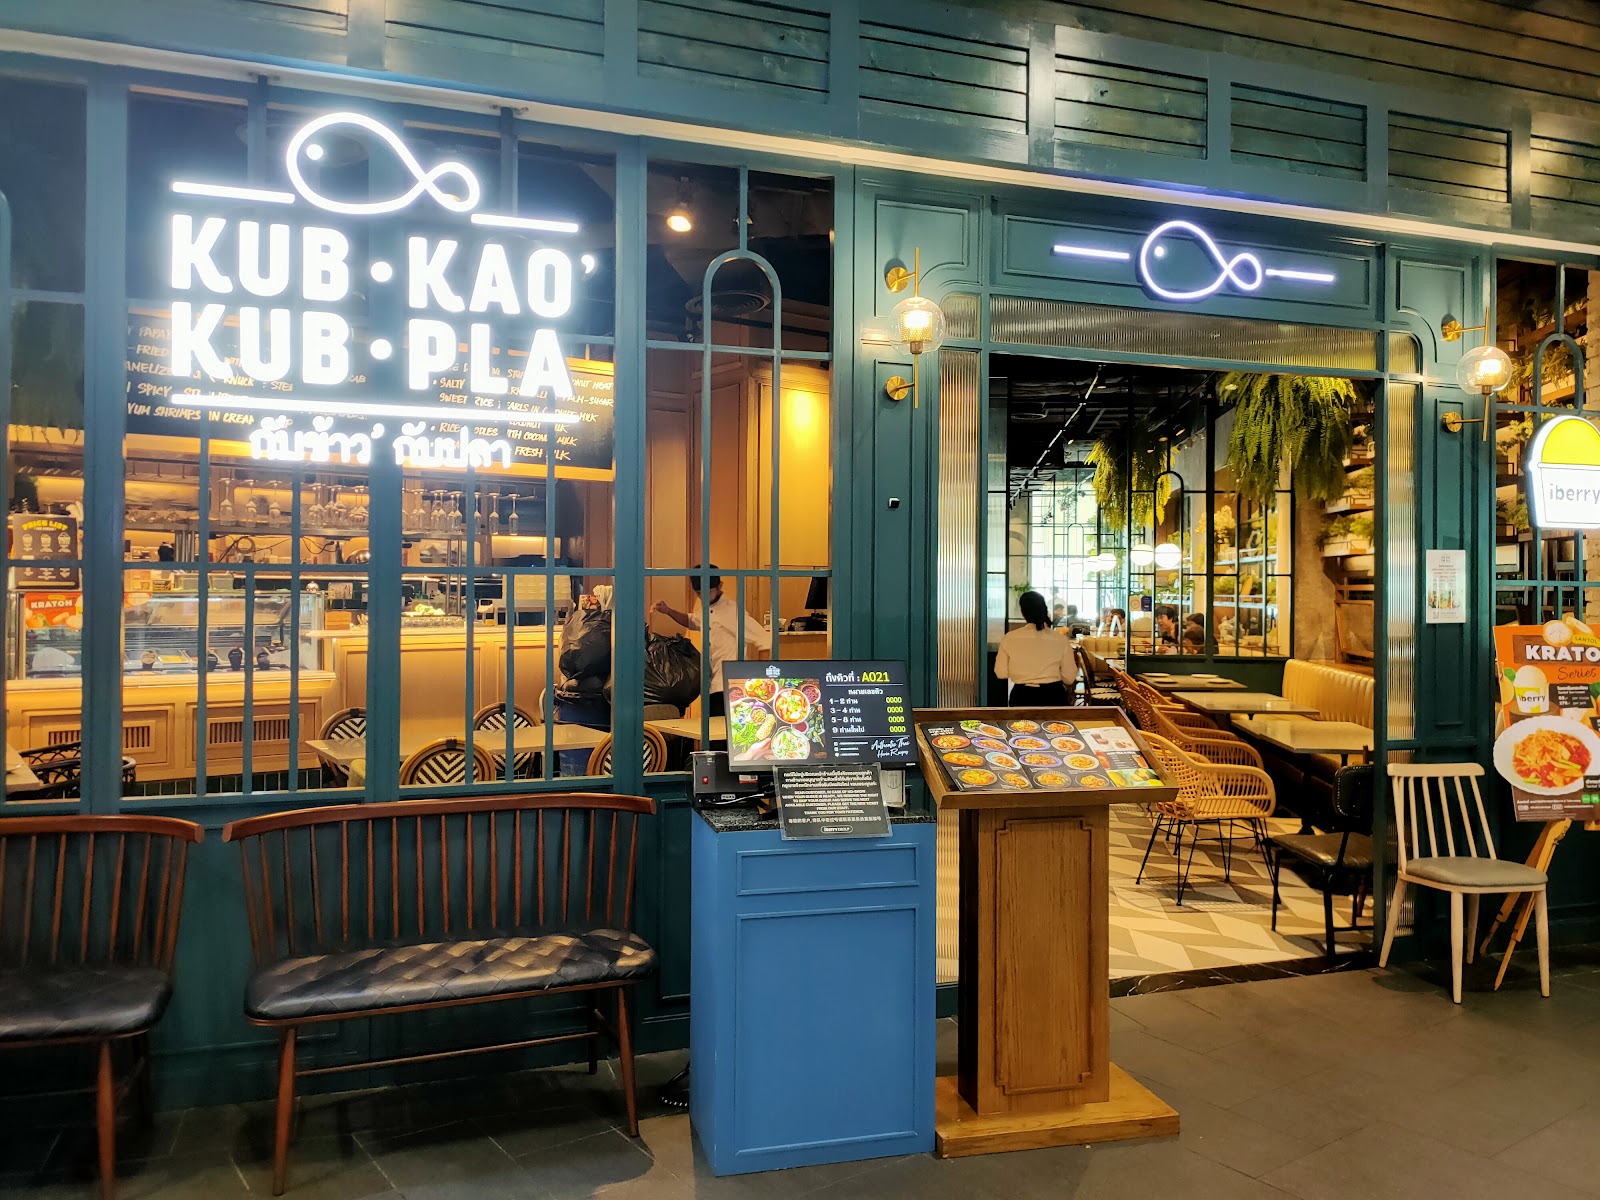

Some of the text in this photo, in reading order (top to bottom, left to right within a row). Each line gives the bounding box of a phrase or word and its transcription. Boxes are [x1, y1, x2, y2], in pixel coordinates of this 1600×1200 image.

[171, 213, 350, 302] KUB
[171, 301, 574, 398] KUB PLA
[138, 382, 173, 398] SPICY
[440, 377, 466, 390] SALTY
[439, 392, 469, 405] SWEET
[127, 402, 151, 416] YUM
[153, 405, 202, 421] SHRIMPS
[208, 410, 221, 422] IN
[392, 420, 512, 469] กับปลา
[515, 446, 543, 458] FRESH
[1549, 483, 1600, 505] iberry
[1574, 636, 1598, 645] SANTOL
[861, 671, 890, 683] A021
[1557, 666, 1597, 680] Series
